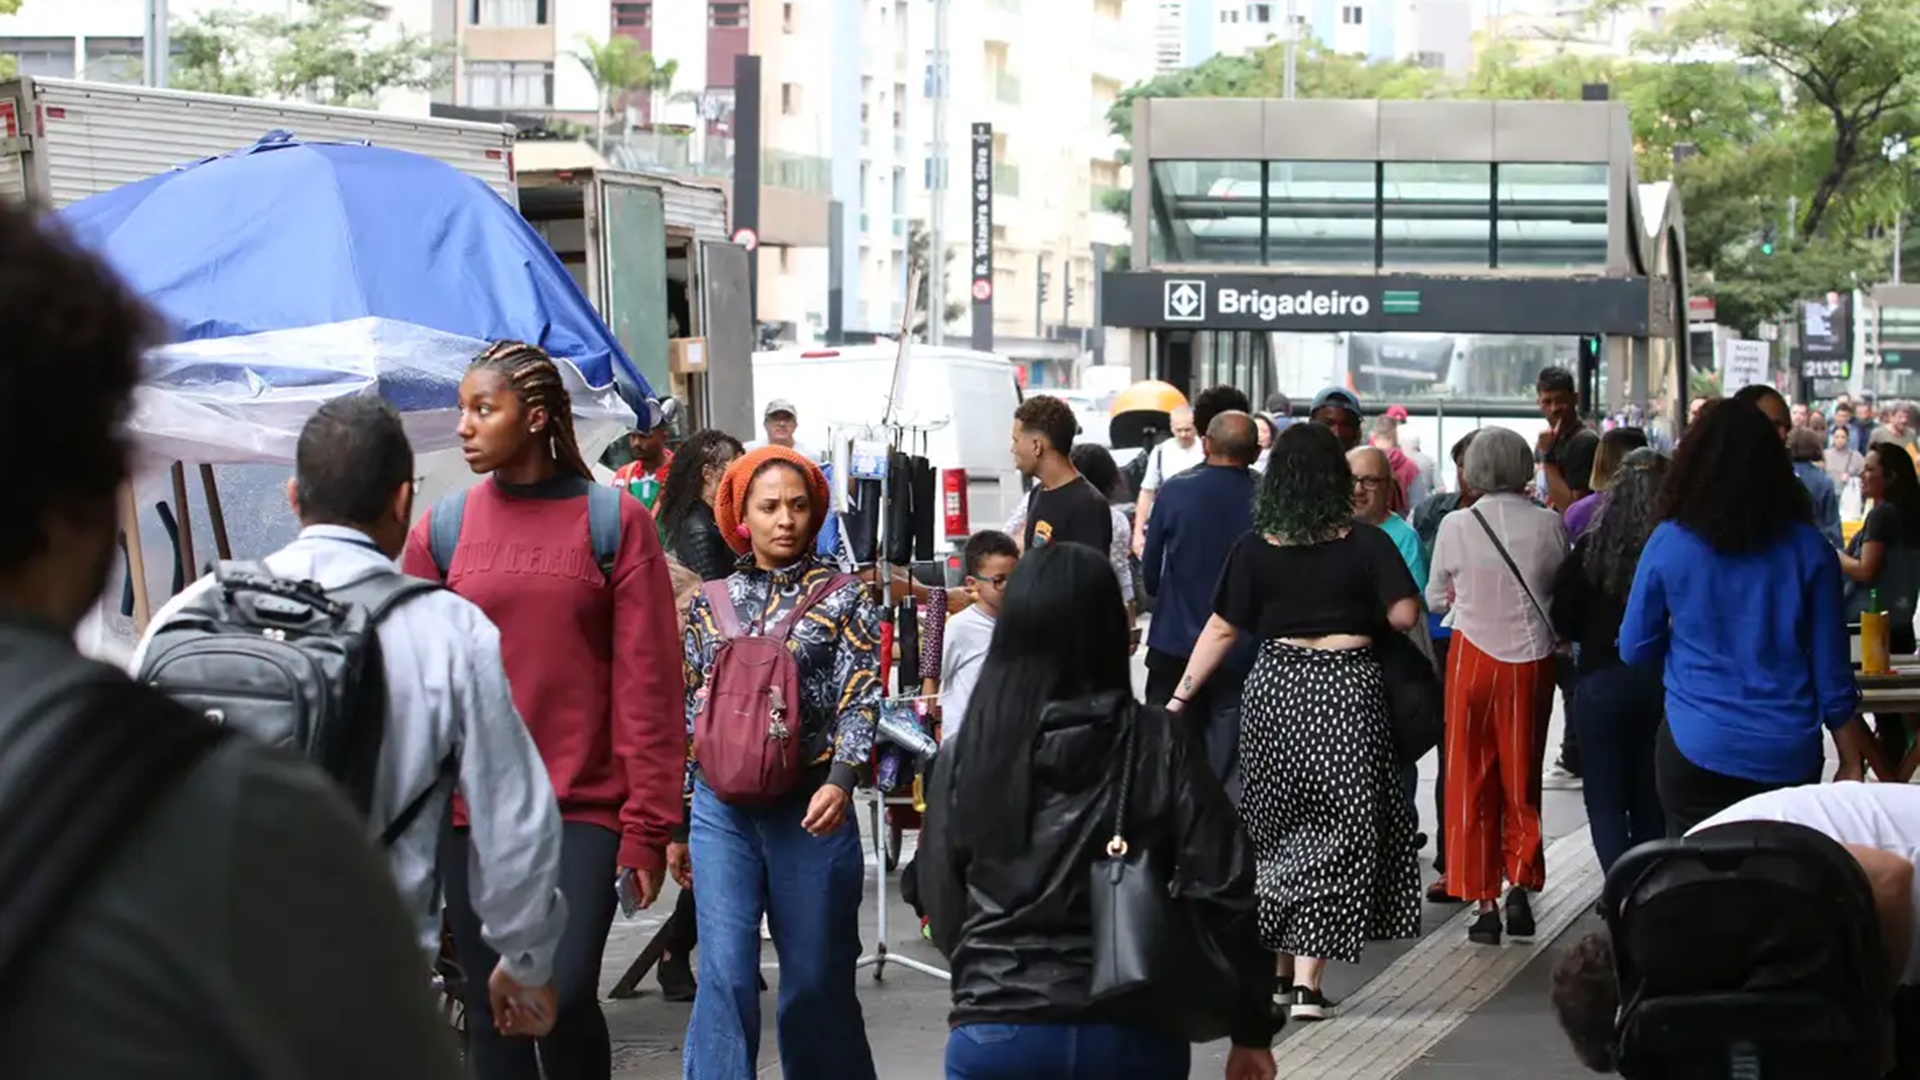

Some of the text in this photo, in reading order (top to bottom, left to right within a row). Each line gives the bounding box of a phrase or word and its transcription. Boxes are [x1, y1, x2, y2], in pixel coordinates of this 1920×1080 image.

[975, 147, 988, 181] Silva
[976, 184, 988, 201] da
[975, 260, 988, 275] R.
[1218, 289, 1370, 321] Brigadeiro
[1805, 360, 1840, 377] 21°C
